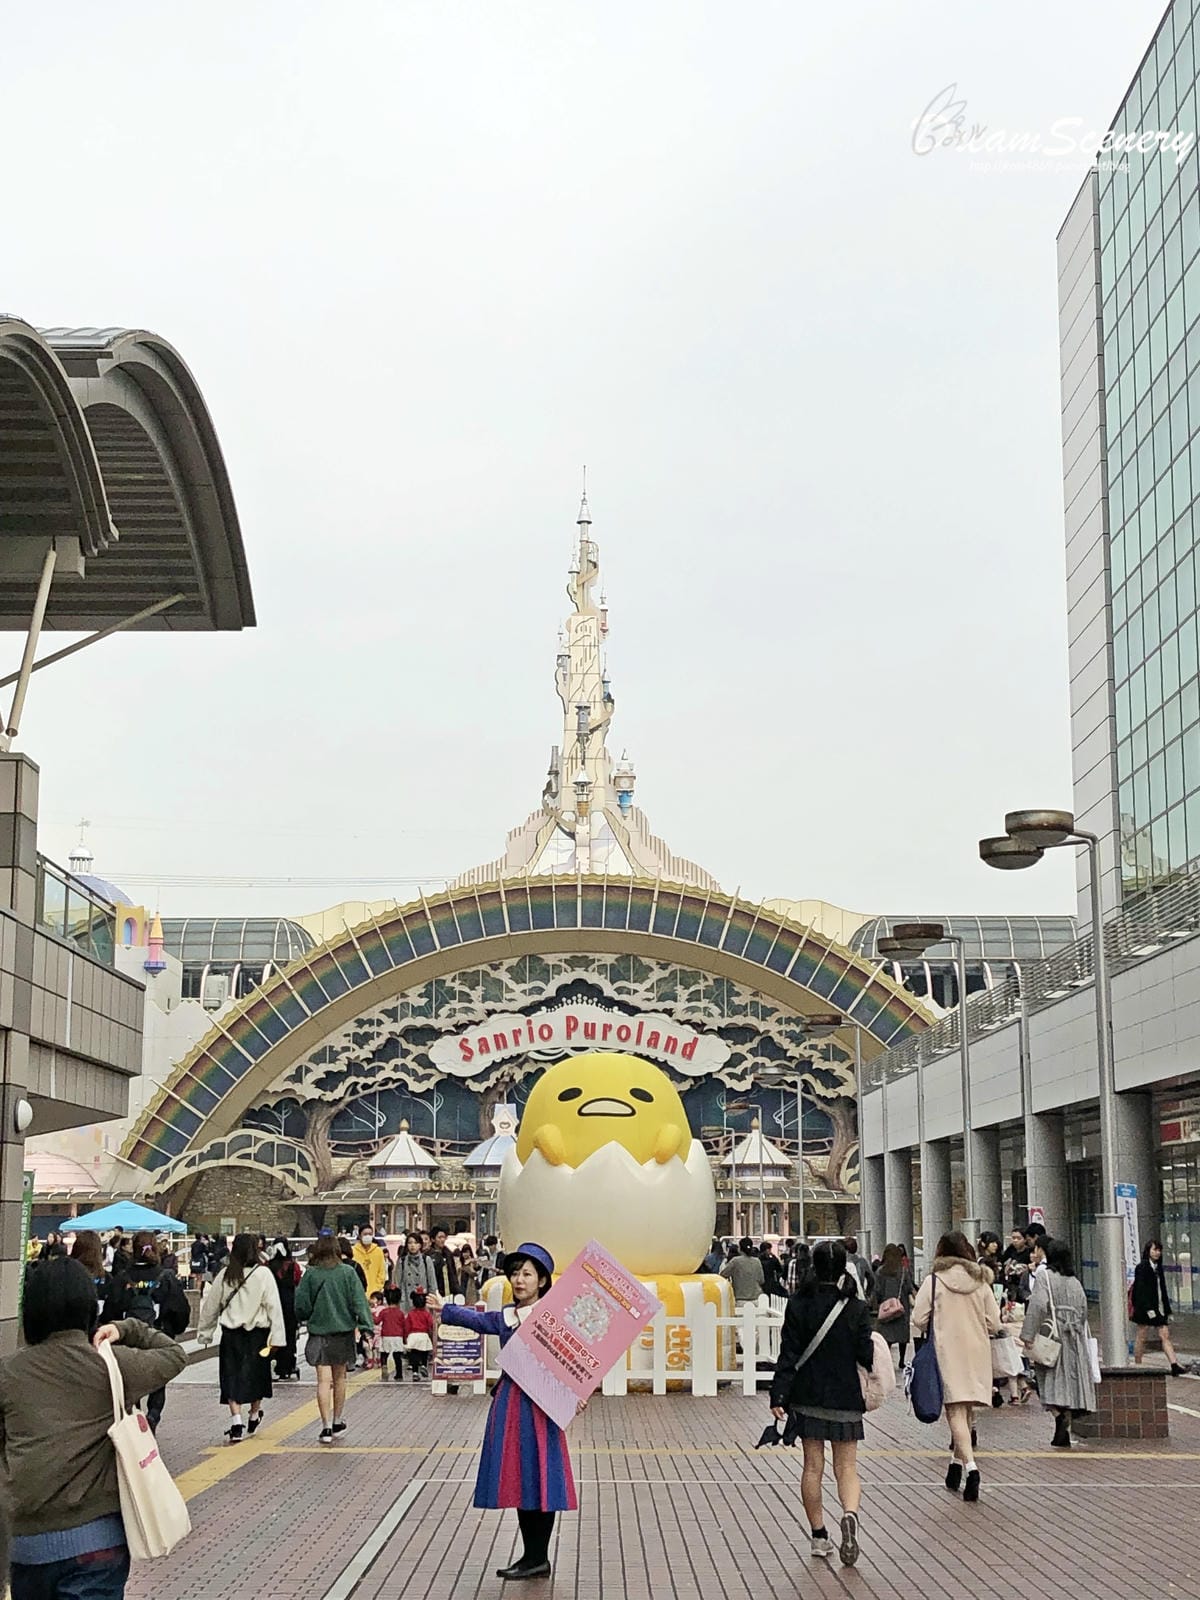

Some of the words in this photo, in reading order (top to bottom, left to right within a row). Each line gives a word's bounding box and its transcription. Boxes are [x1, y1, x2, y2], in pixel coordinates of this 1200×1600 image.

[458, 1019, 554, 1063] Sanrio
[565, 1015, 699, 1061] Puroland
[418, 1180, 478, 1192] TICKETS
